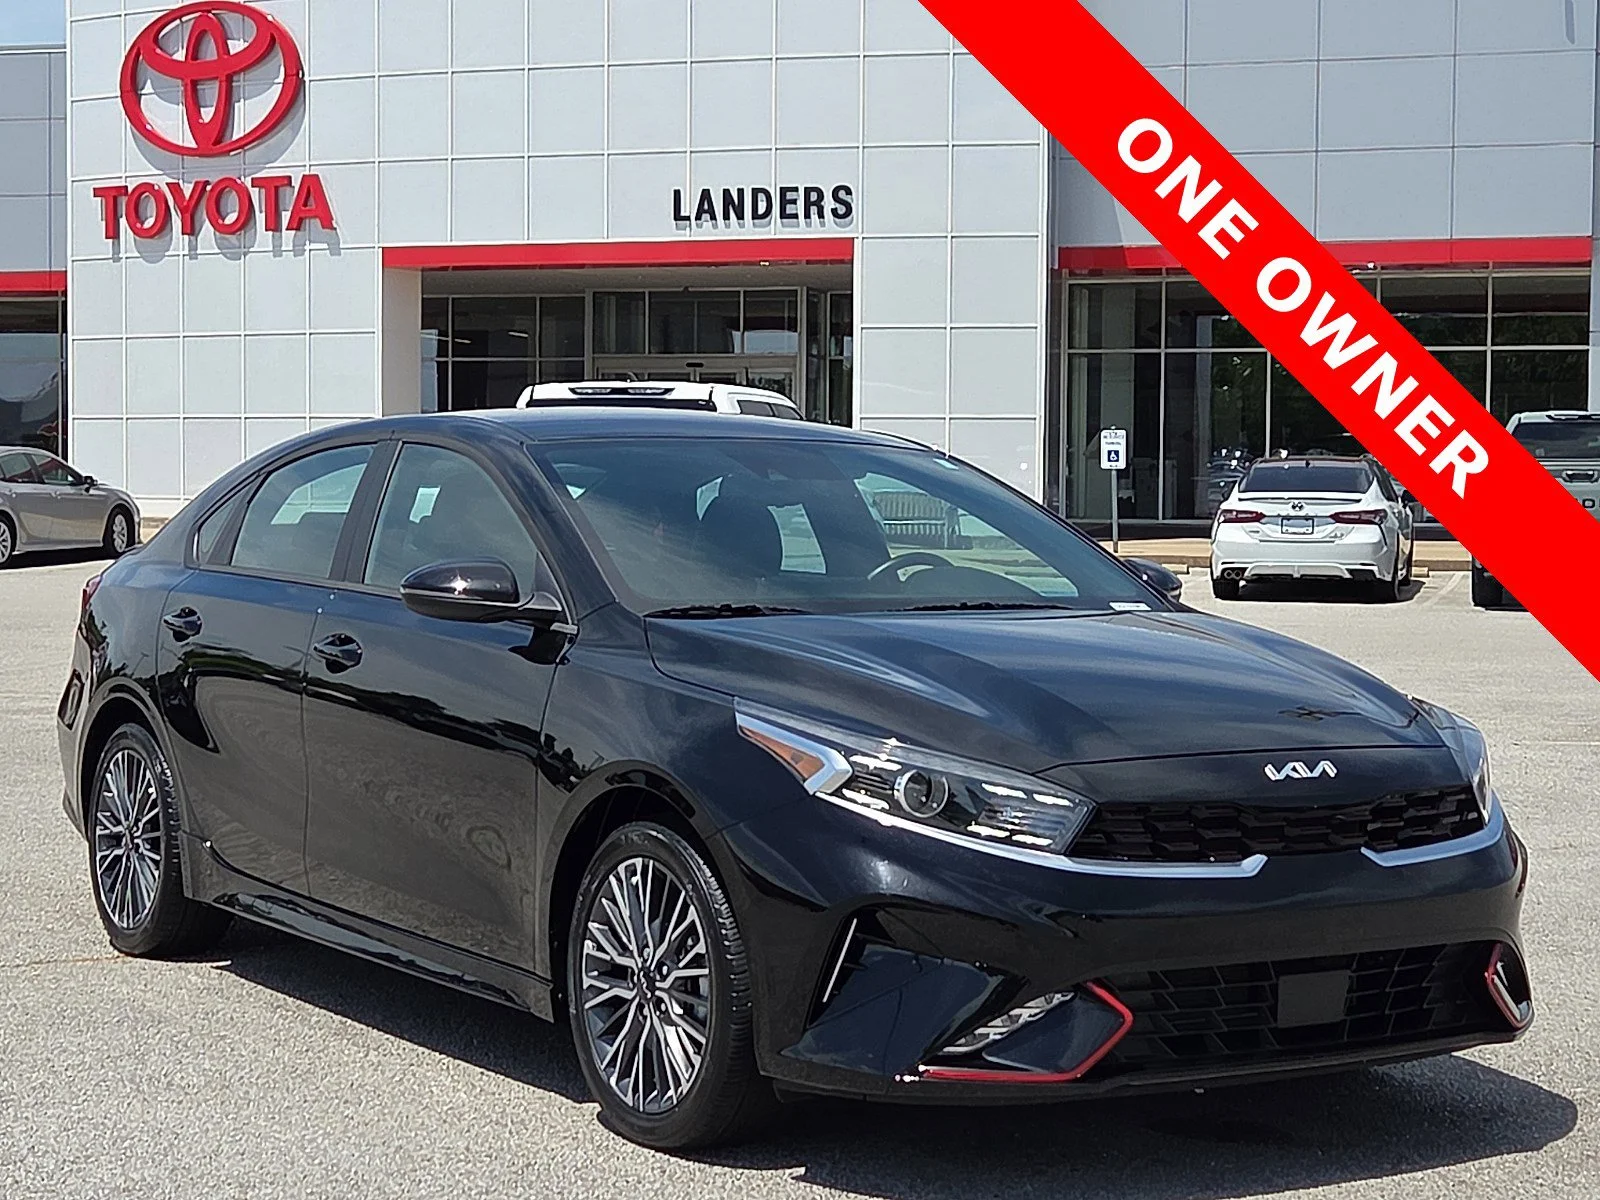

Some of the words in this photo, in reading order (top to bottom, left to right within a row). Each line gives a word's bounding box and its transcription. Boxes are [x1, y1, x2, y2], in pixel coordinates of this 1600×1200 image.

[93, 174, 335, 239] TOYOTA
[673, 185, 853, 221] LANDERS
[1264, 760, 1338, 781] KIA
